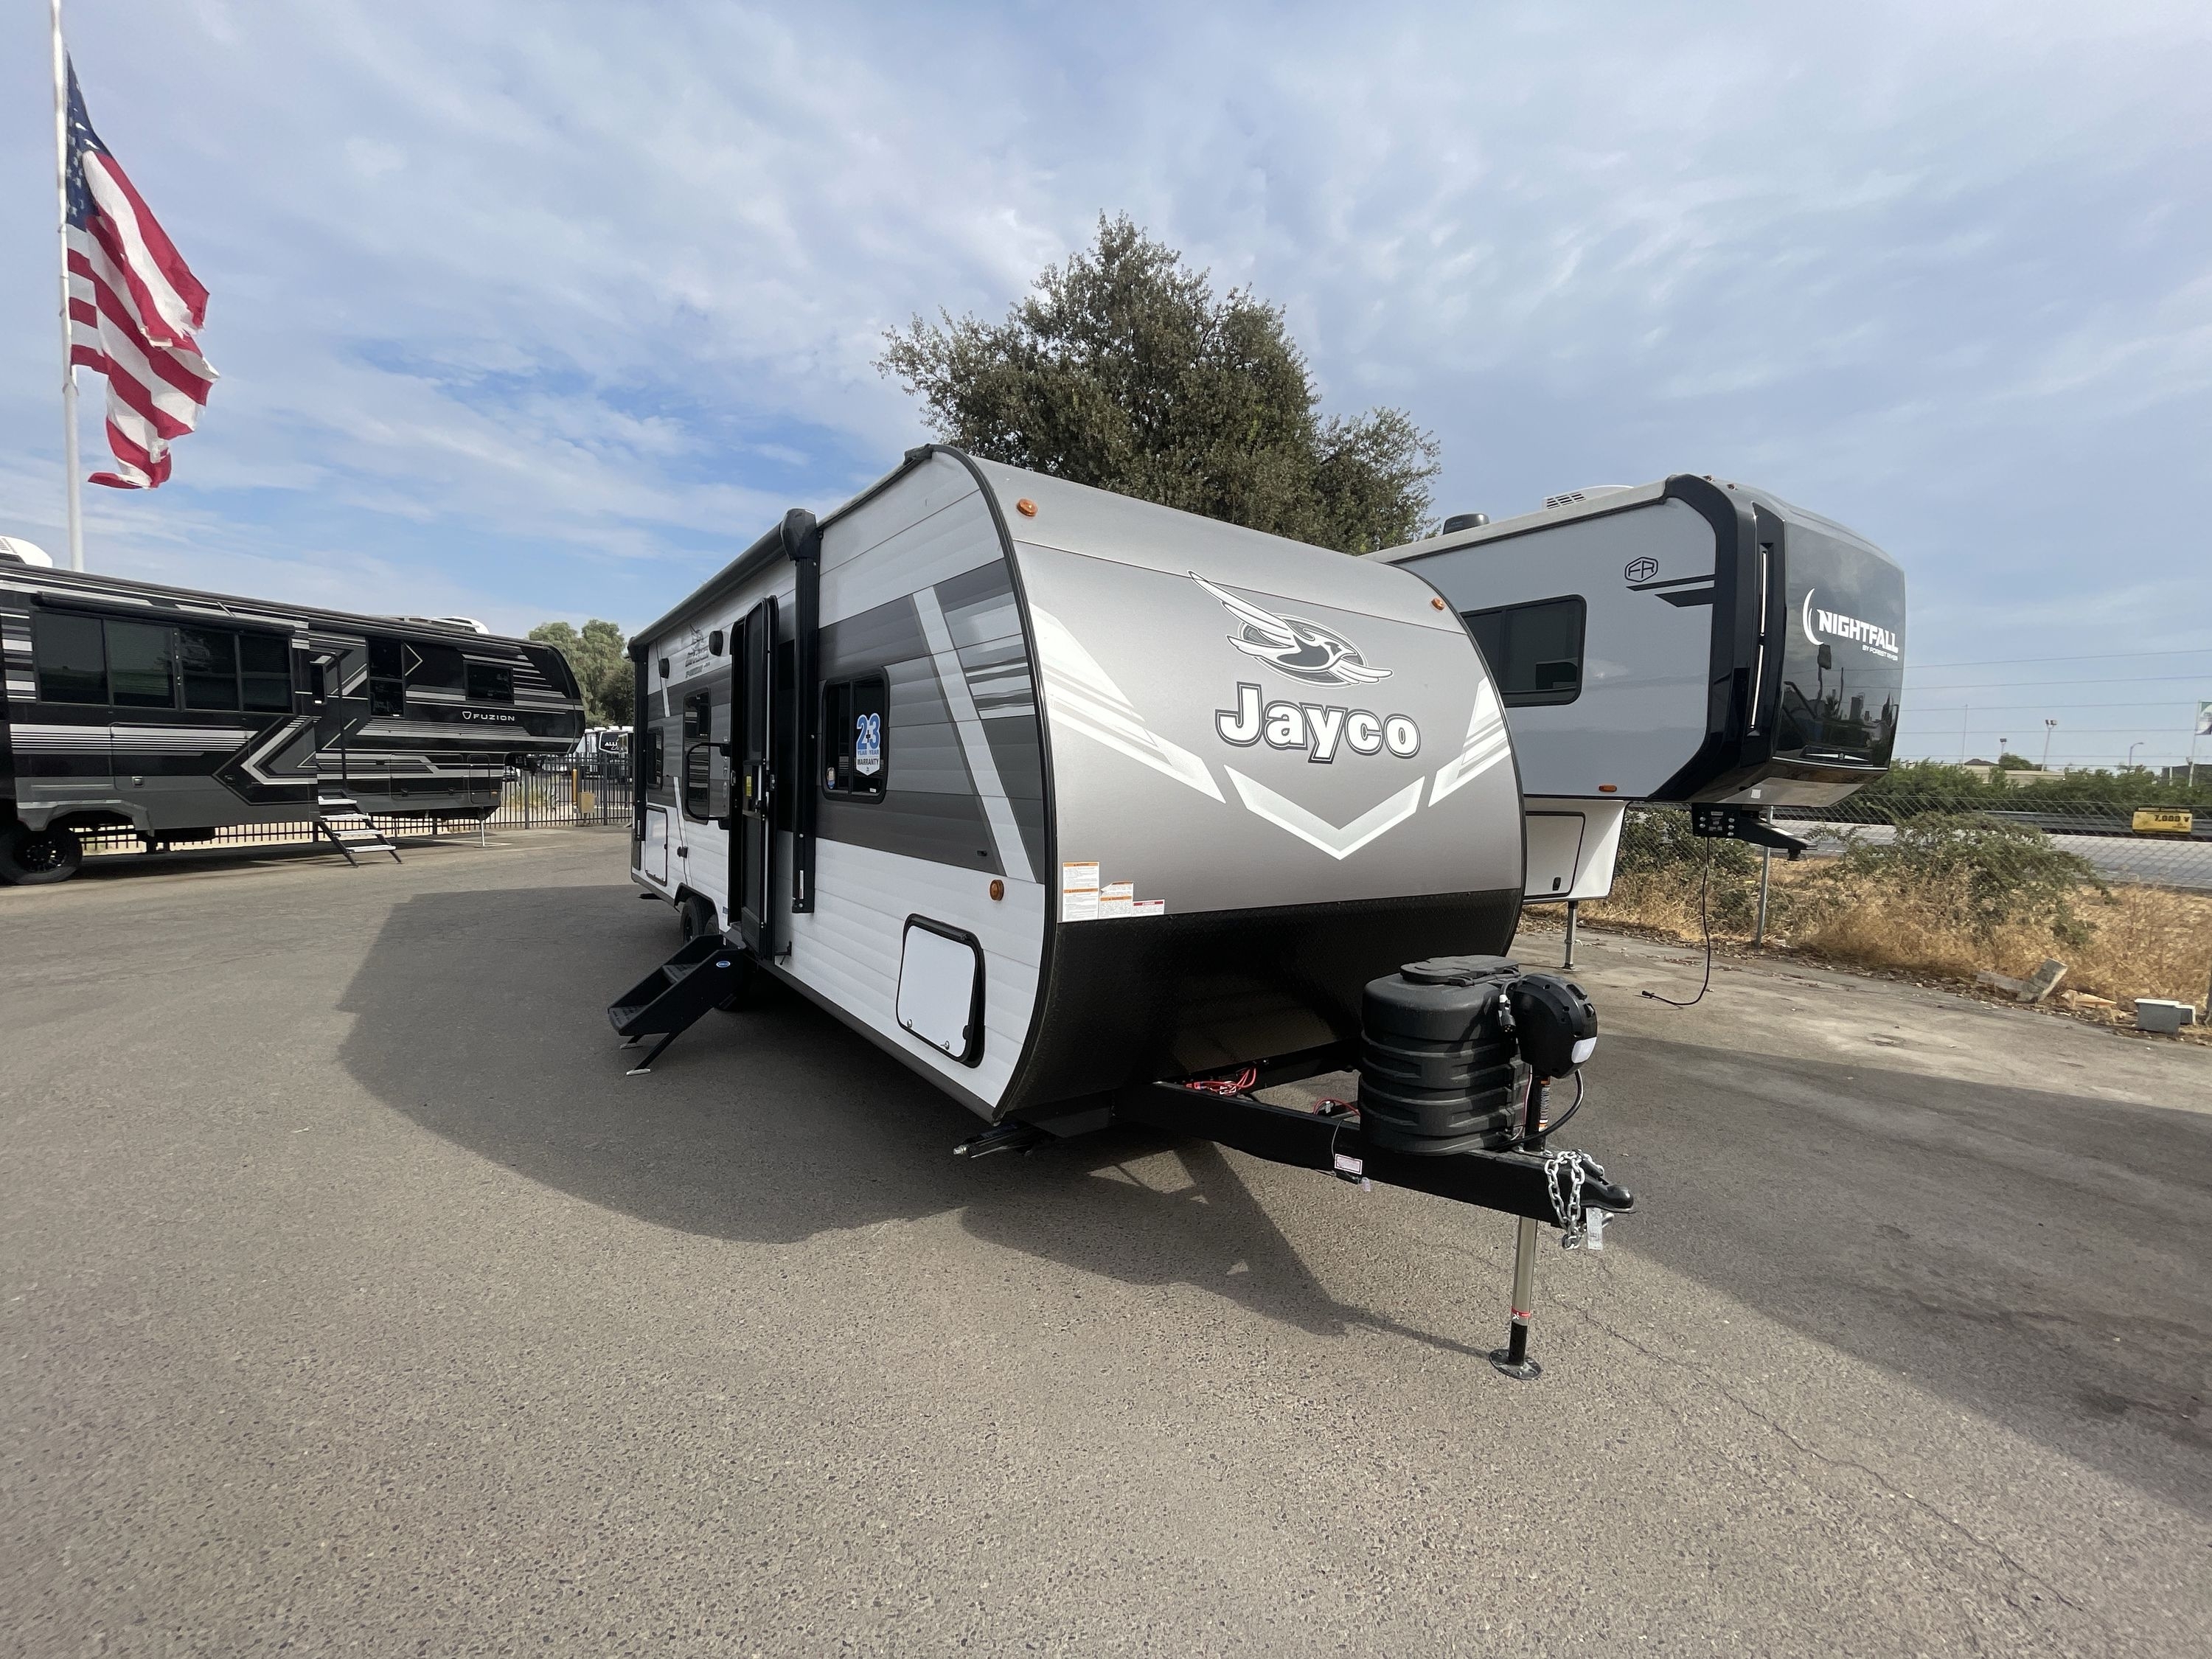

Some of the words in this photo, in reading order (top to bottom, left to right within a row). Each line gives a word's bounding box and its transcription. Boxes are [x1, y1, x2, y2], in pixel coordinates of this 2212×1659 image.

[1816, 608, 1899, 654] NIGHTFALL
[1869, 647, 1888, 657] FOREST
[473, 713, 515, 722] FUZION
[1214, 681, 1421, 765] Jayco
[857, 758, 880, 766] WARRANTY
